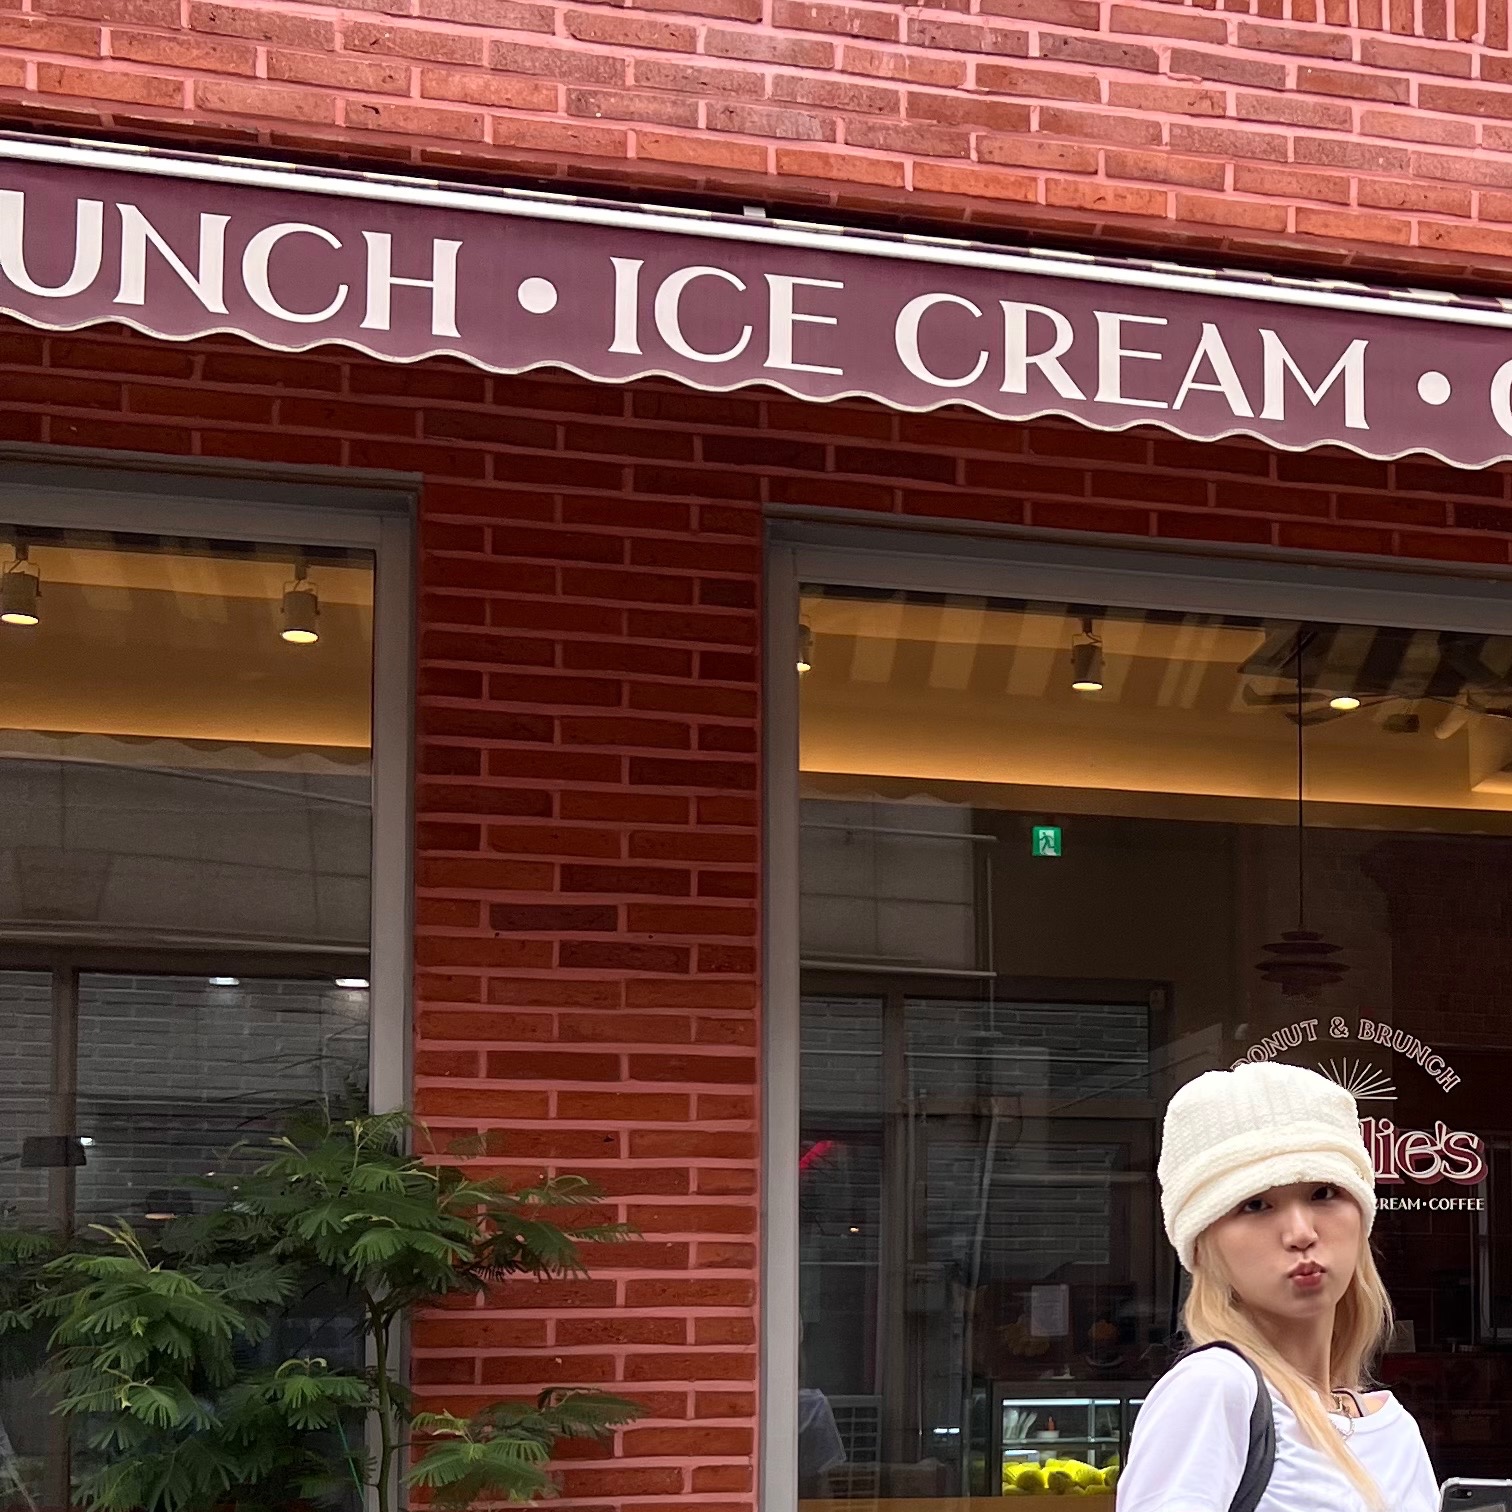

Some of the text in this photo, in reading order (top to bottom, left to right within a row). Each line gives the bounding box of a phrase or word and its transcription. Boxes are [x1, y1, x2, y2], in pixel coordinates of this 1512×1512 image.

[0, 190, 463, 338] UNCH
[608, 256, 844, 376] ICE
[895, 292, 1369, 430] CREAM
[1329, 1016, 1349, 1038] &
[1358, 1018, 1461, 1093] BRUNCH
[1428, 1197, 1485, 1211] COFFEE
